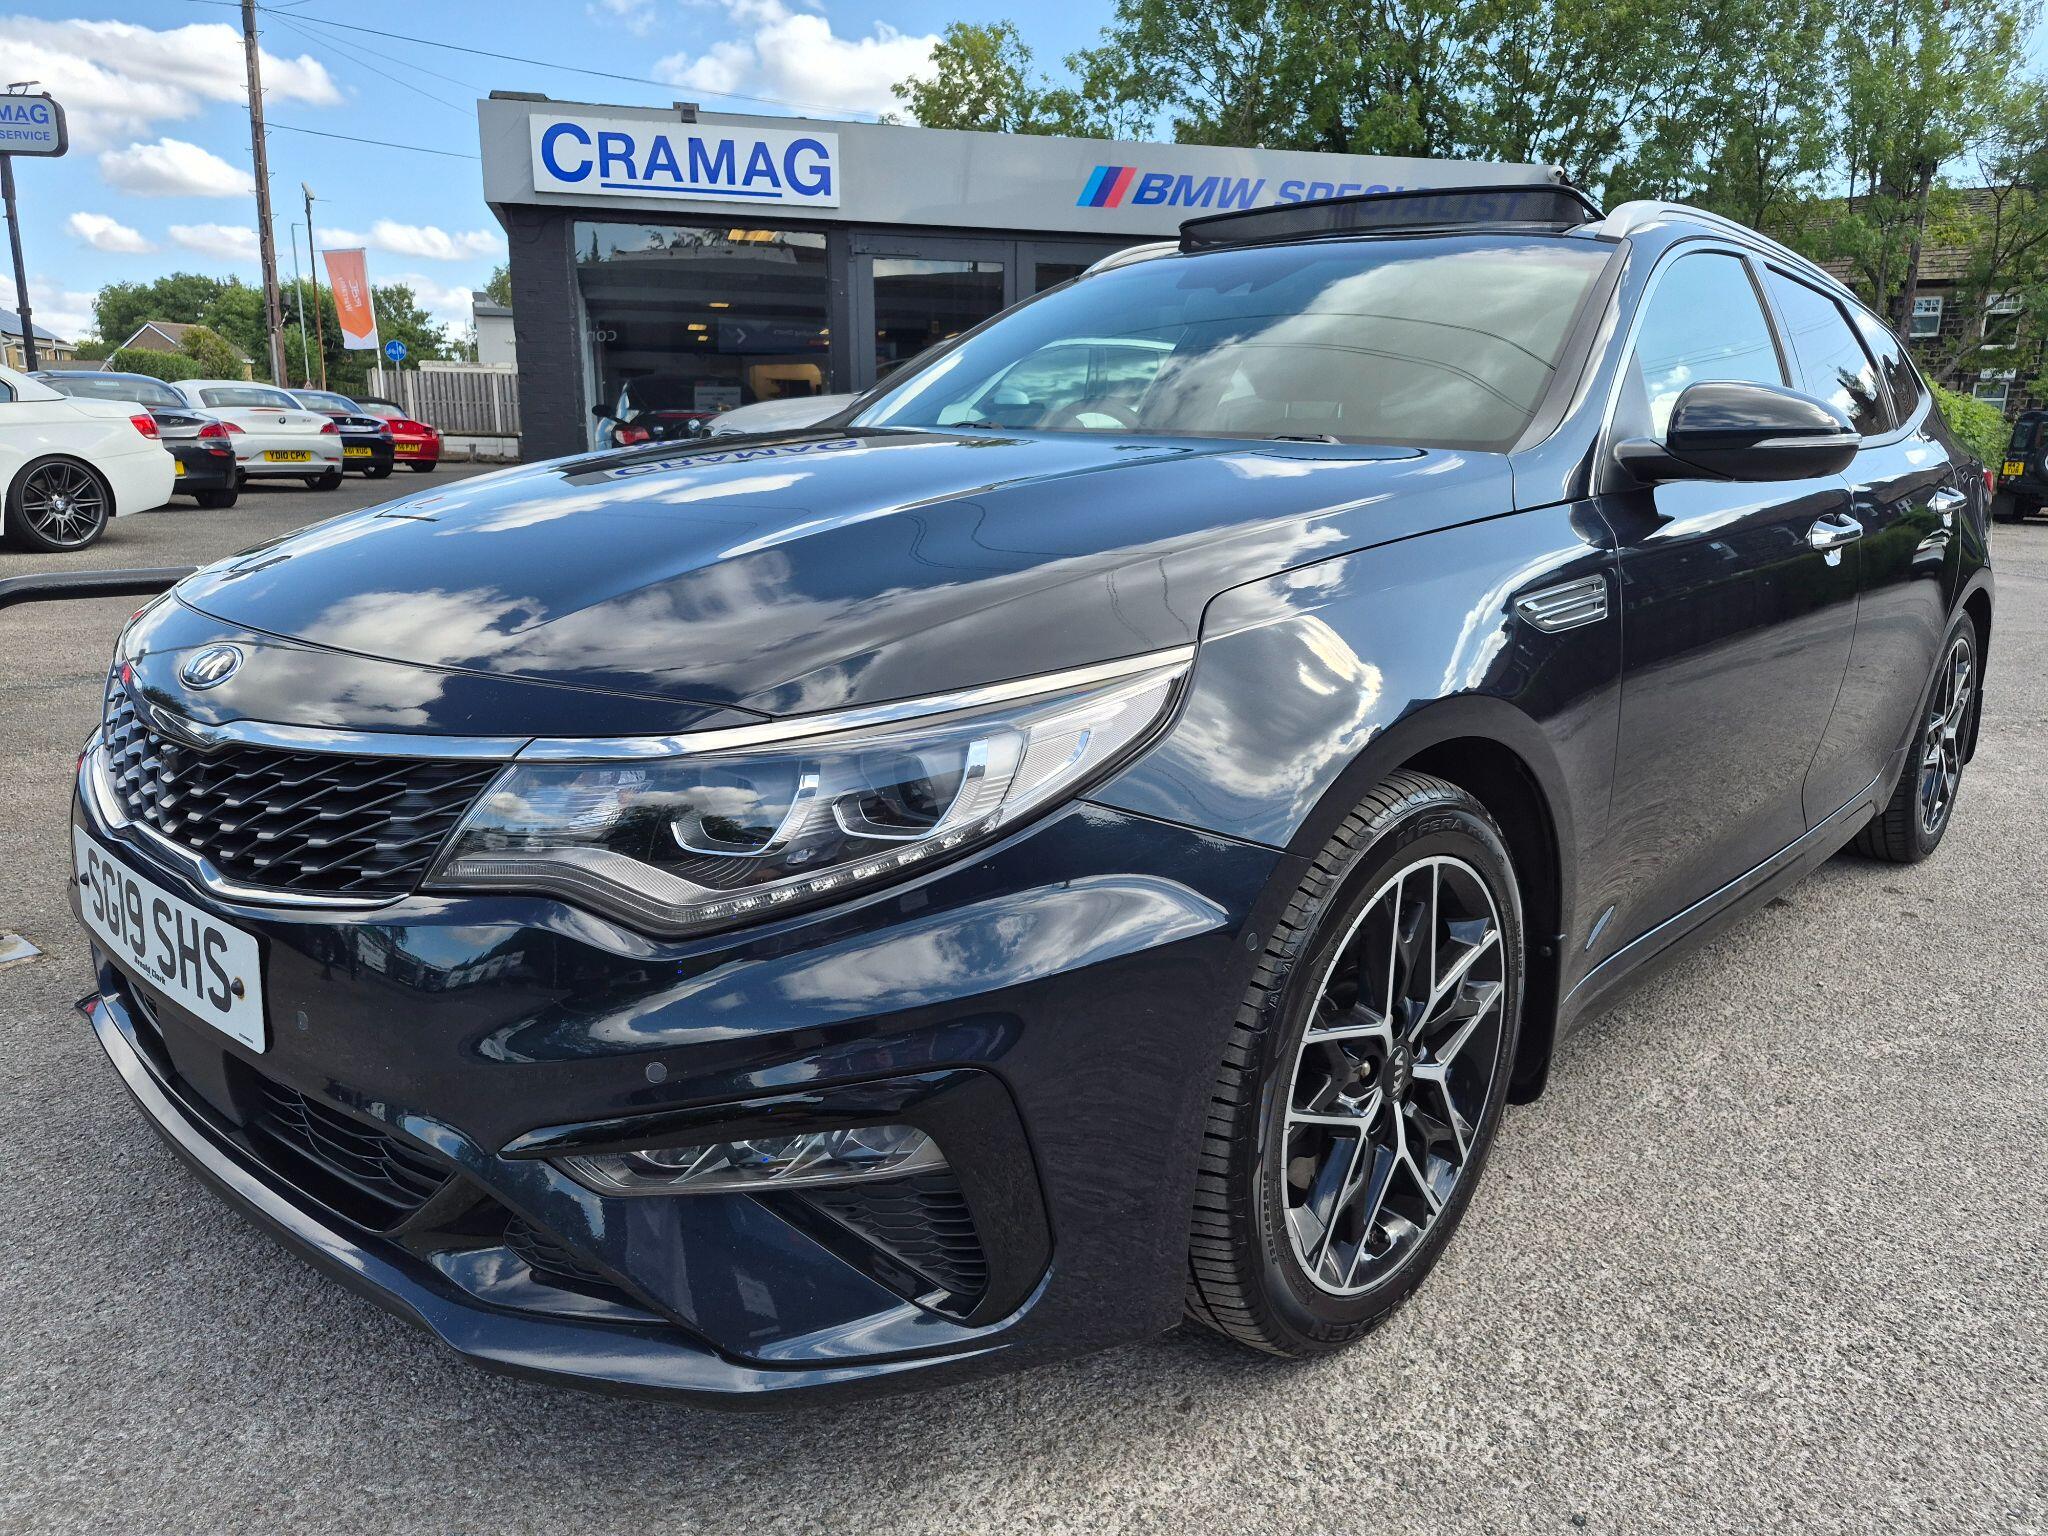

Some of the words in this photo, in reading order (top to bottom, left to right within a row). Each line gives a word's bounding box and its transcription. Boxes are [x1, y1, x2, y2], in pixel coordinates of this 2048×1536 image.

[0, 130, 50, 141] SERVICE
[541, 122, 832, 196] CRAMAG
[1132, 173, 1265, 209] BMW
[269, 451, 288, 460] YD10
[290, 451, 307, 460] CPK
[88, 848, 146, 957] SG19
[153, 898, 231, 1012] SHS
[1392, 1051, 1404, 1093] KIA
